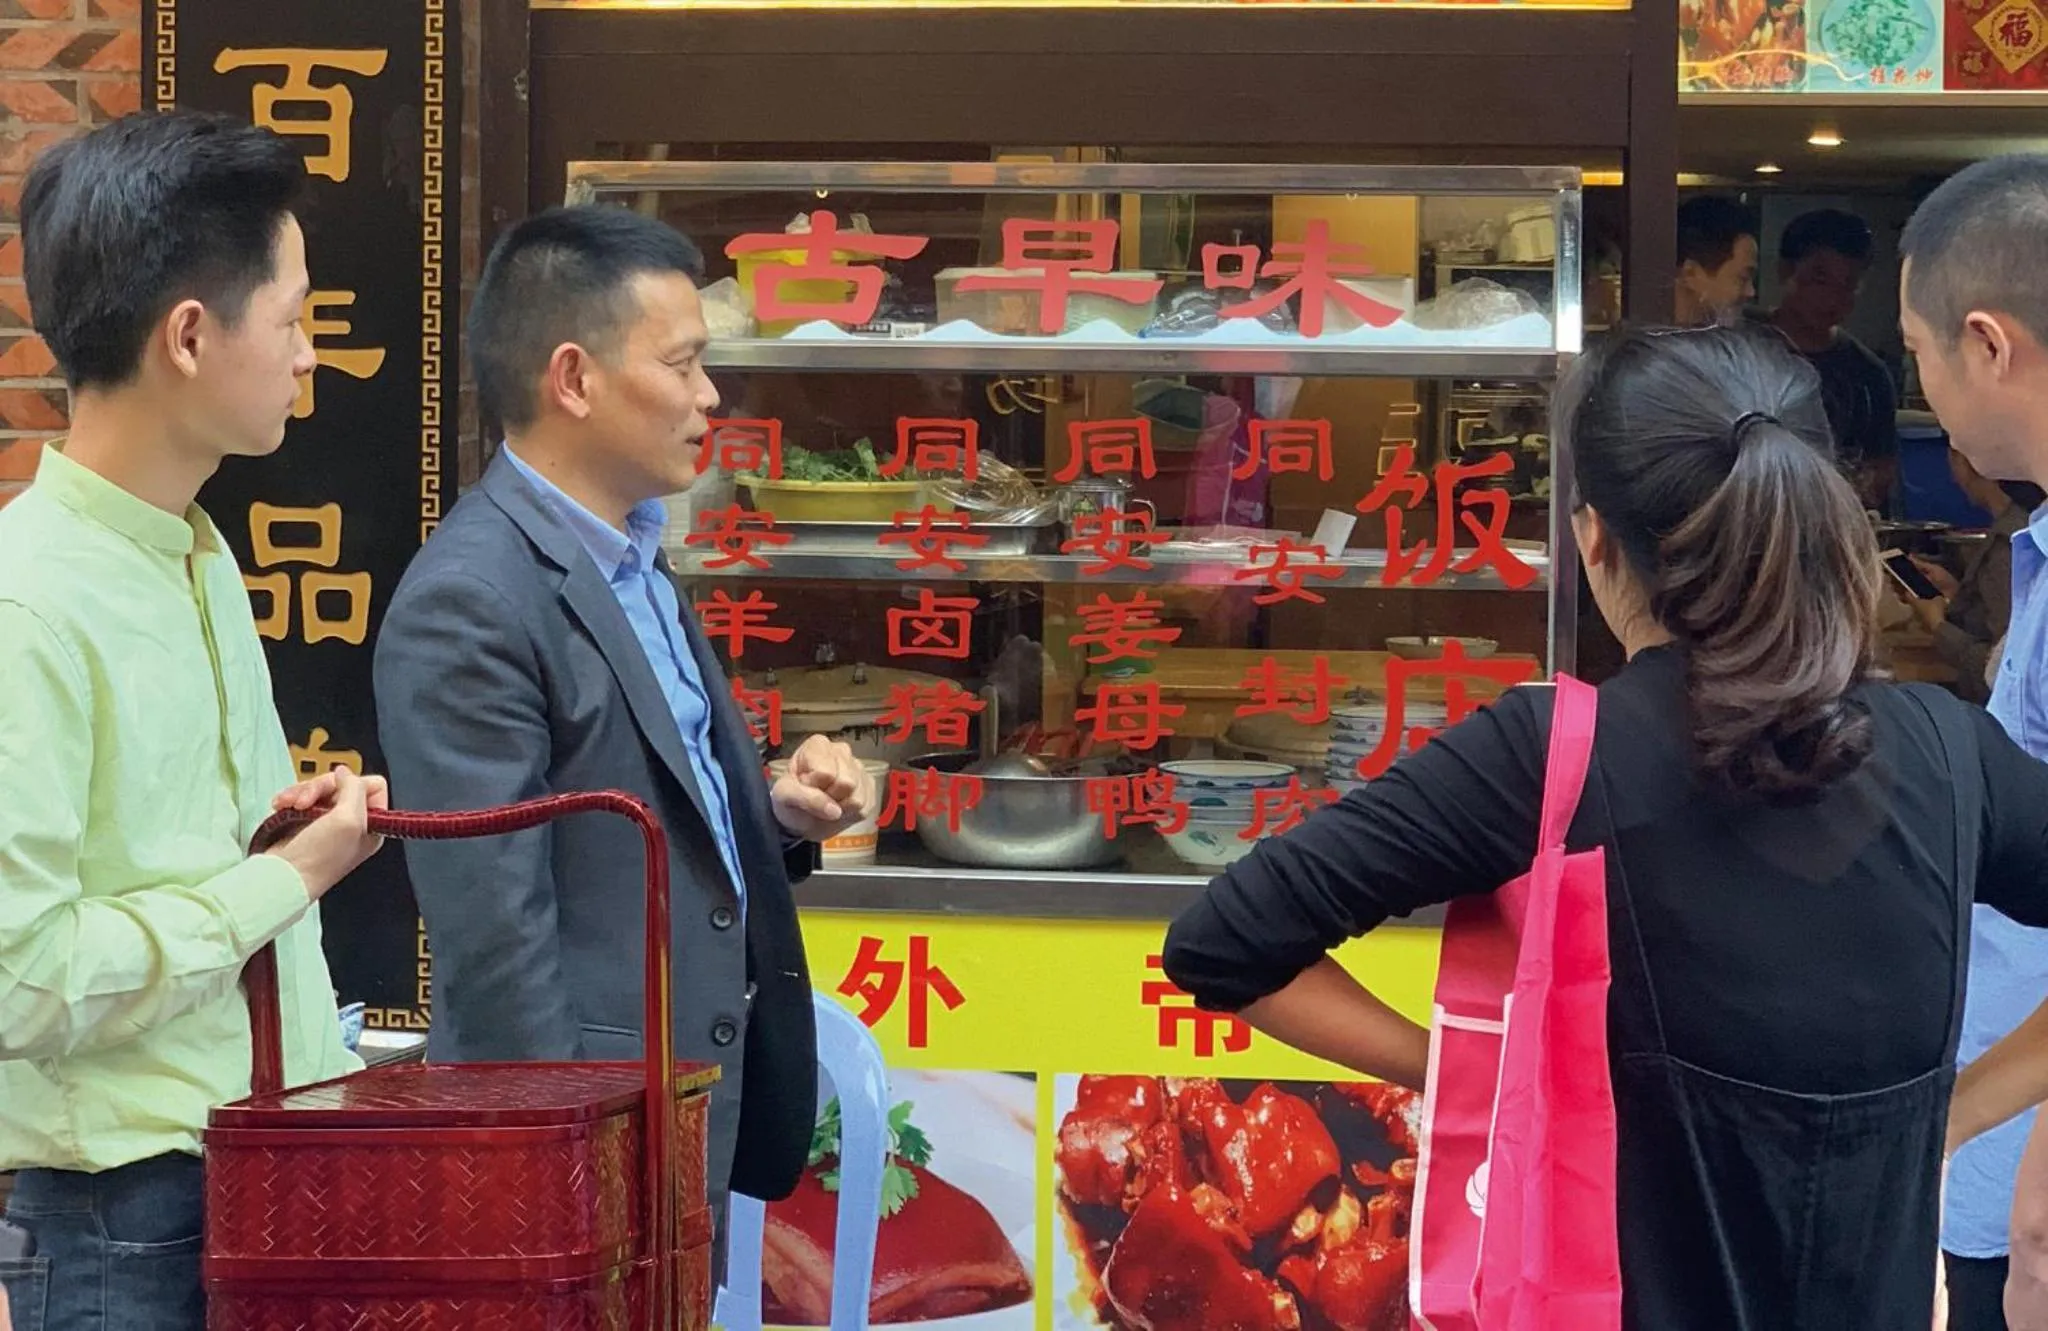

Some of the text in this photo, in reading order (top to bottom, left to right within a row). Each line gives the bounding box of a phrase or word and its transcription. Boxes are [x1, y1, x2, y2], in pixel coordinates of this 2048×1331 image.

[724, 210, 1407, 338] 古早味
[685, 416, 796, 780] 同安羊肉
[875, 416, 990, 834] 同安卤猪脚
[1054, 416, 1190, 840] 同安姜母鸭
